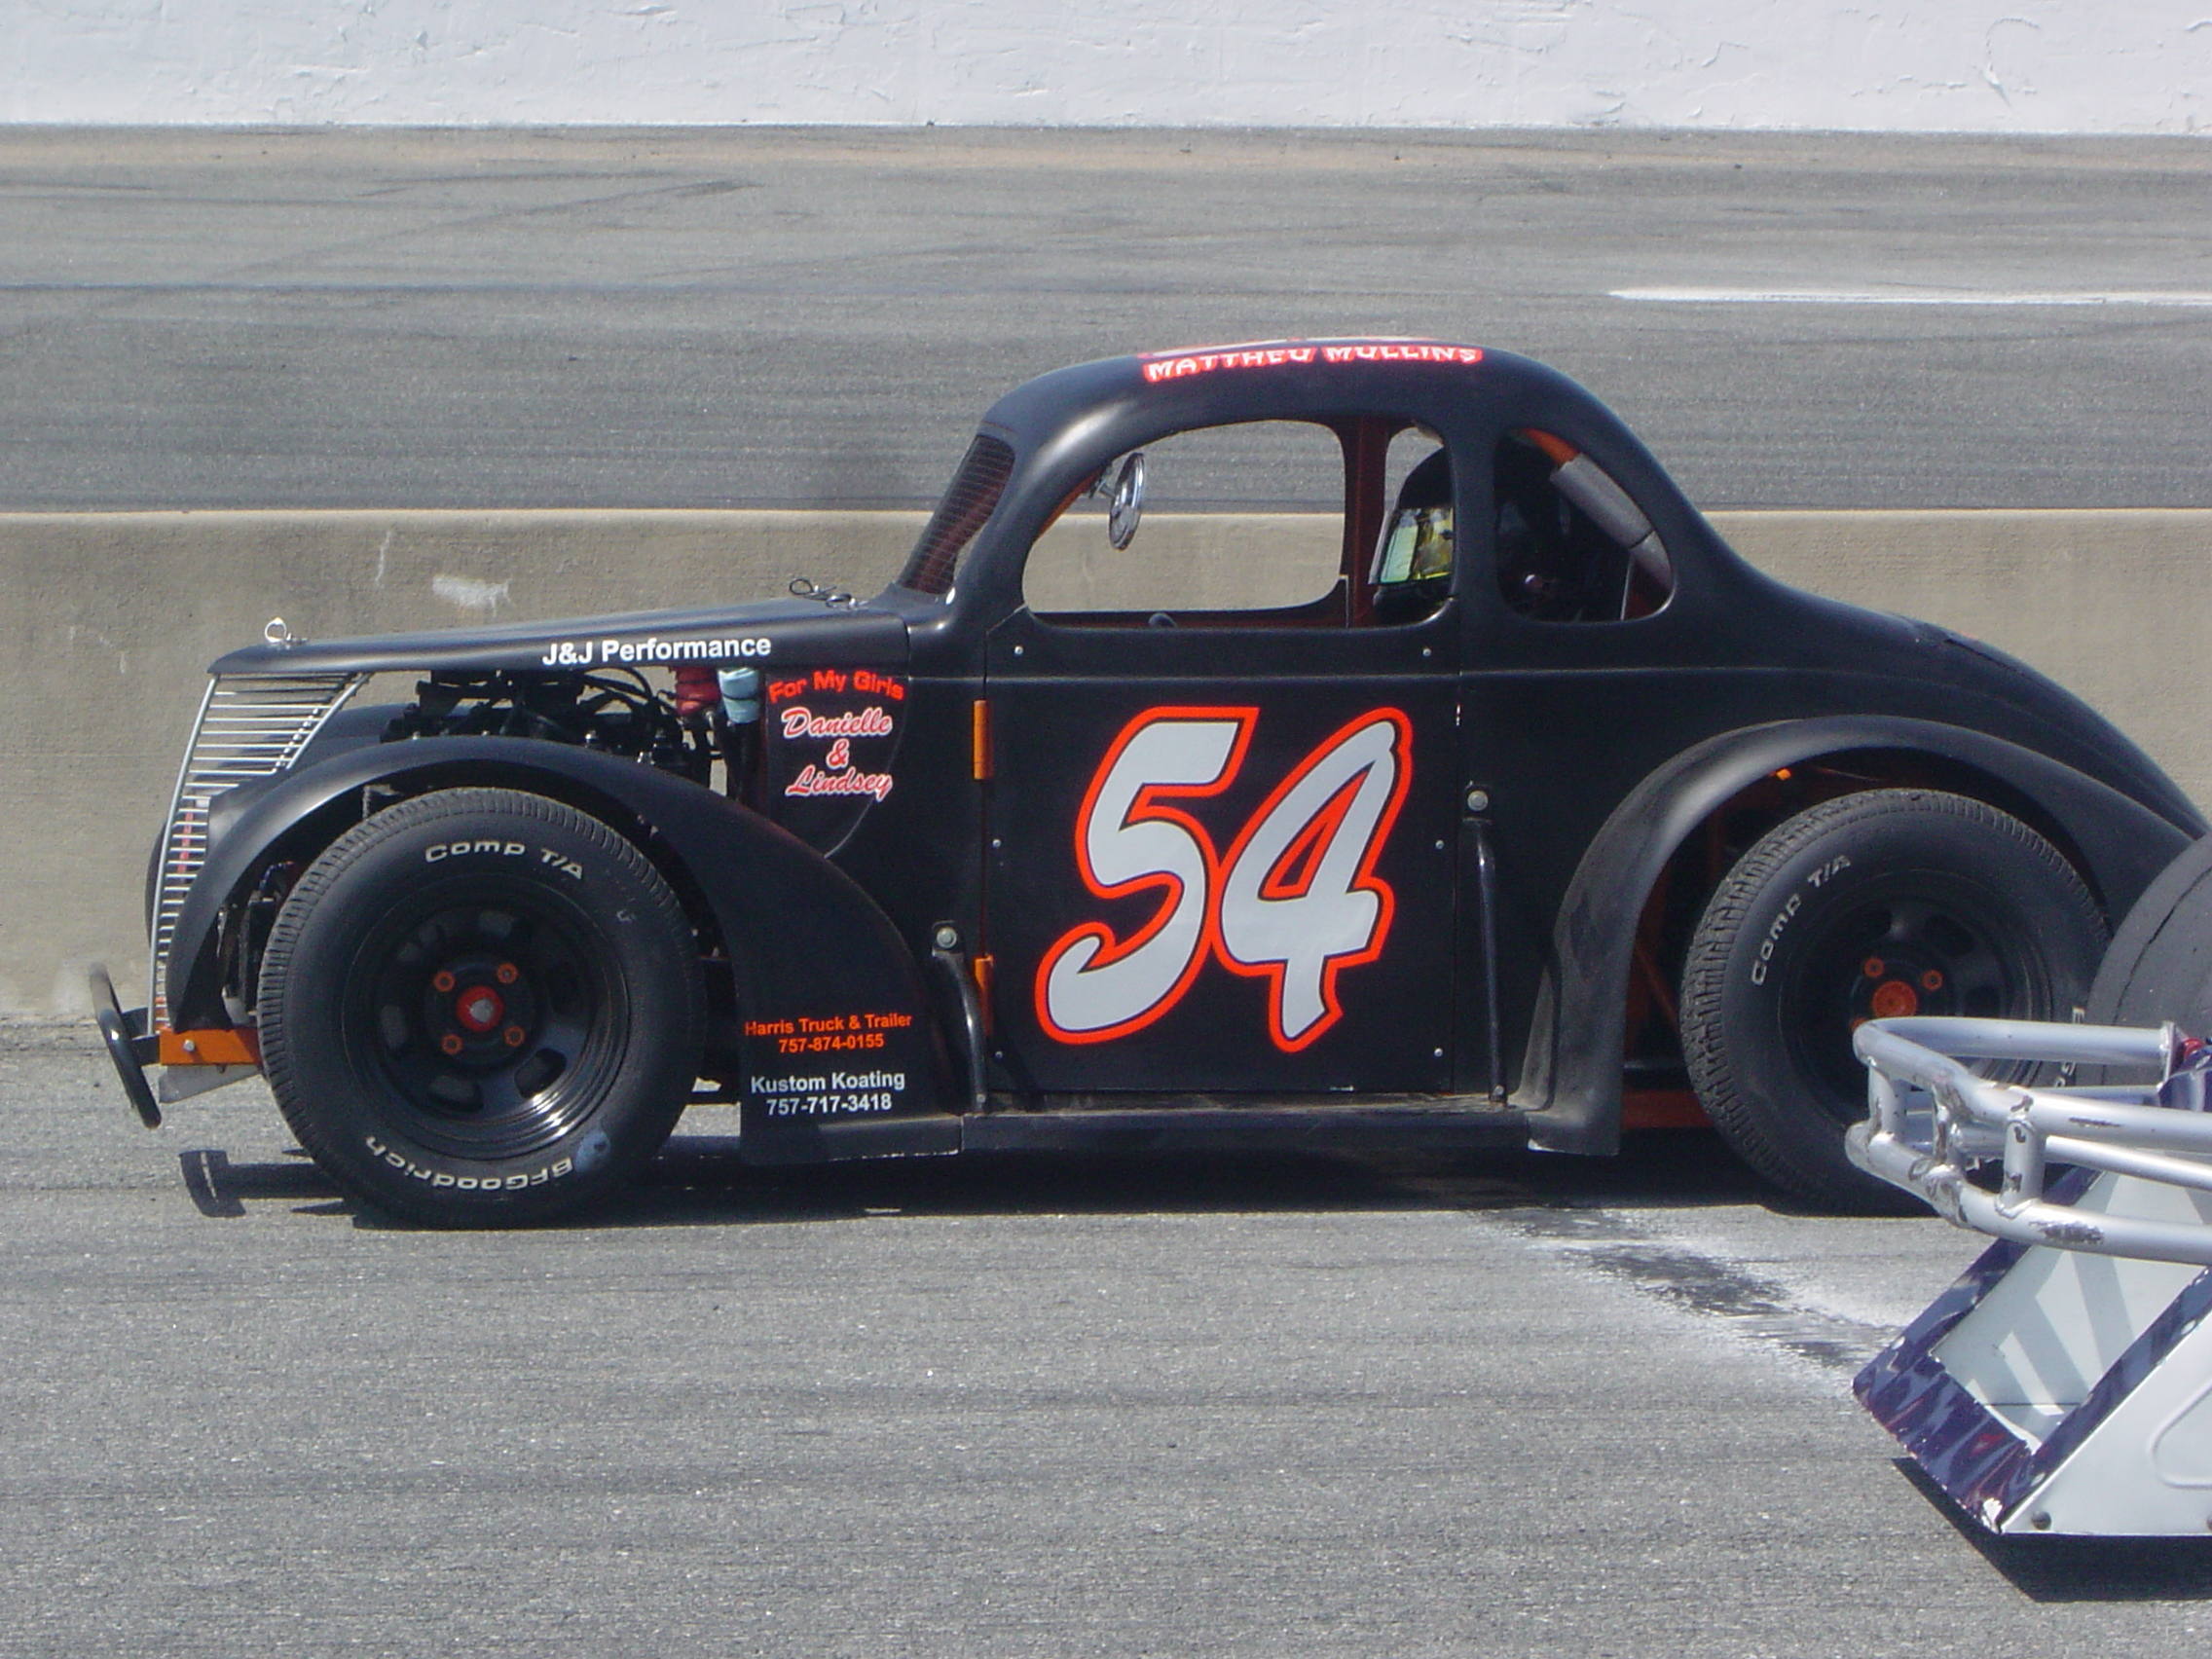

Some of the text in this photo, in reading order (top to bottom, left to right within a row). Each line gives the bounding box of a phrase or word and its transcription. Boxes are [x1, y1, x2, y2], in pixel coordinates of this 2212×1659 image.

[1321, 345, 1482, 363] MULLINS
[542, 637, 772, 666] J&J Performance
[769, 670, 904, 704] For My Girls
[782, 707, 894, 738] Danielle
[826, 739, 850, 768] &
[785, 764, 894, 802] Lindsey
[541, 847, 583, 880] T/A
[1807, 854, 1851, 888] T/A
[1035, 706, 1413, 1052] 54
[745, 1013, 912, 1036] Harris Truck & Trailer
[779, 1033, 884, 1053] 757-874-0155
[751, 1070, 905, 1094] Kustom Koating
[766, 1092, 892, 1116] 757-717-3418
[365, 1135, 573, 1190] BFGoodrich
